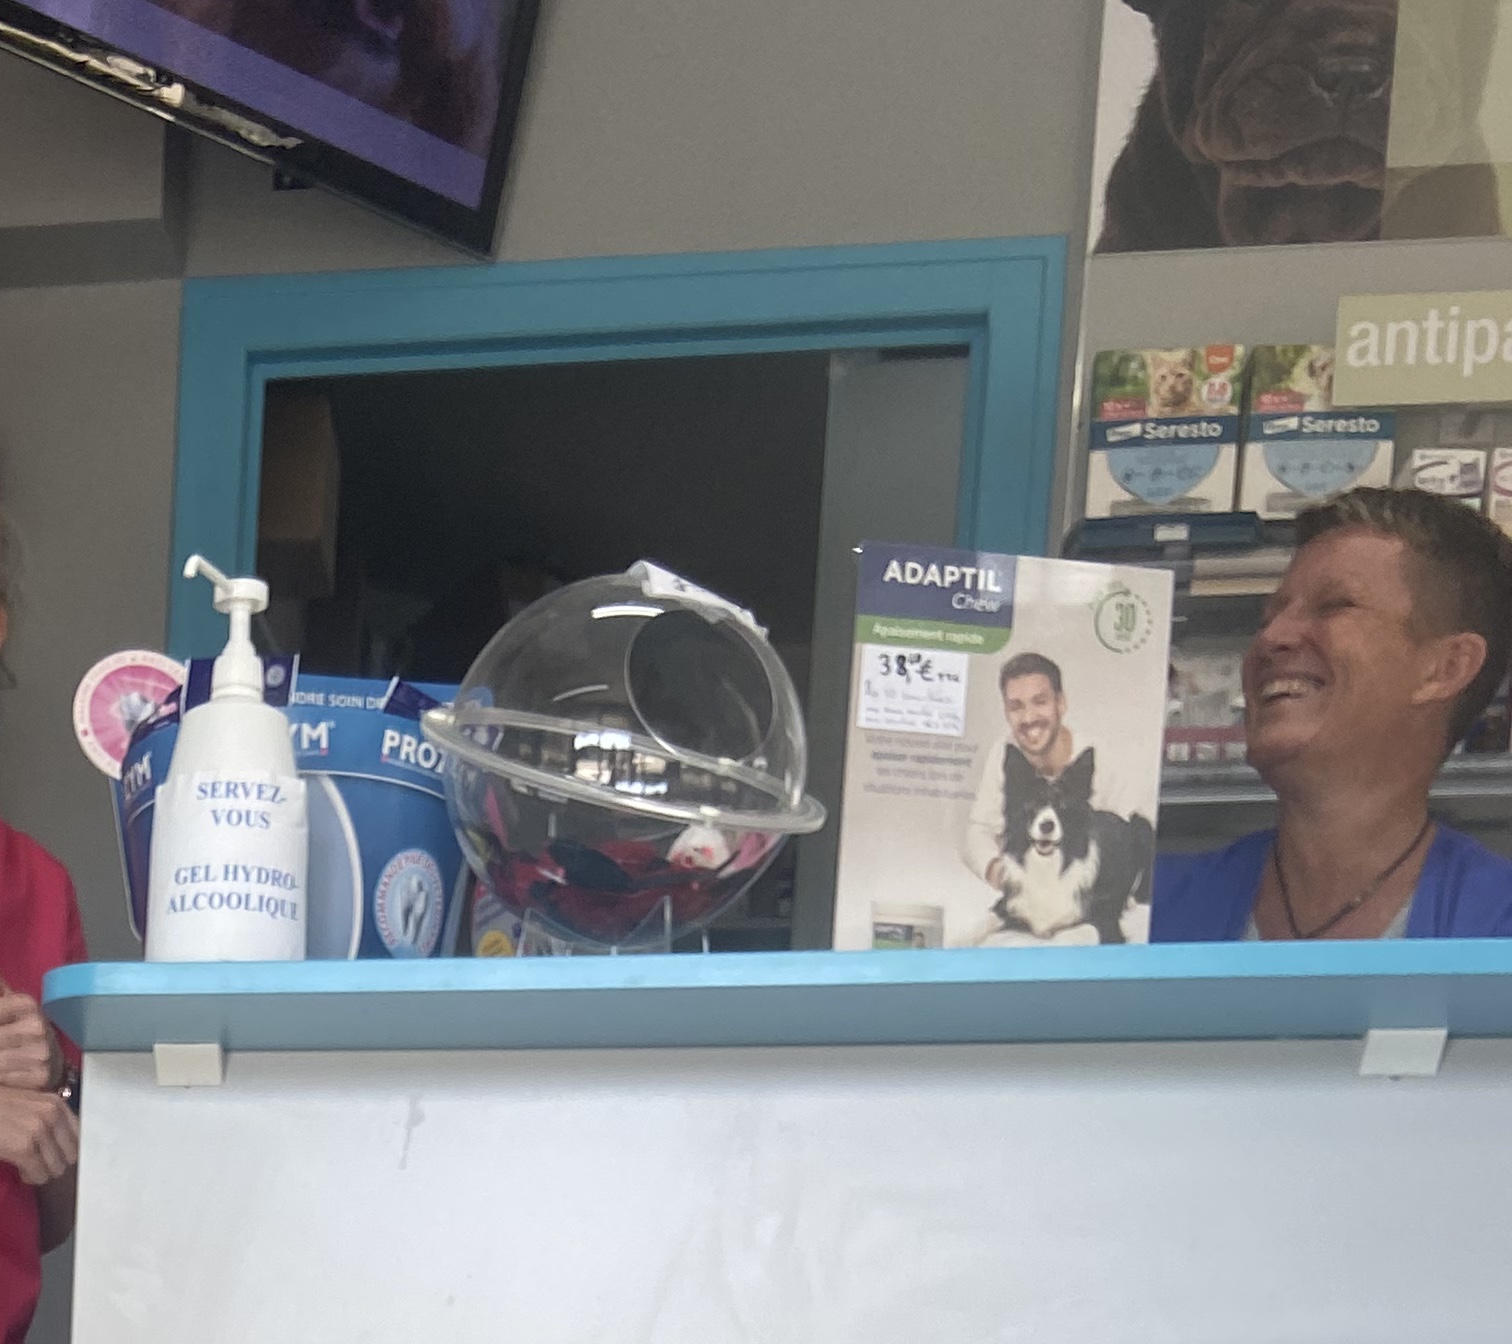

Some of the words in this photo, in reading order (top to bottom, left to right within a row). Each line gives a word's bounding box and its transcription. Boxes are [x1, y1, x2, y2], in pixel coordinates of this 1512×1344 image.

[1346, 306, 1512, 377] antip
[1143, 422, 1223, 440] Seresto
[1301, 416, 1381, 433] Seresto
[883, 559, 1003, 593] ADAPTIL
[327, 693, 365, 708] SOIN
[196, 780, 288, 804] SERVEZ-
[210, 808, 272, 830] VOUS
[173, 864, 217, 886] GEL
[223, 863, 300, 891] HYDRO-
[166, 891, 300, 921] ALCOOLIQUE
